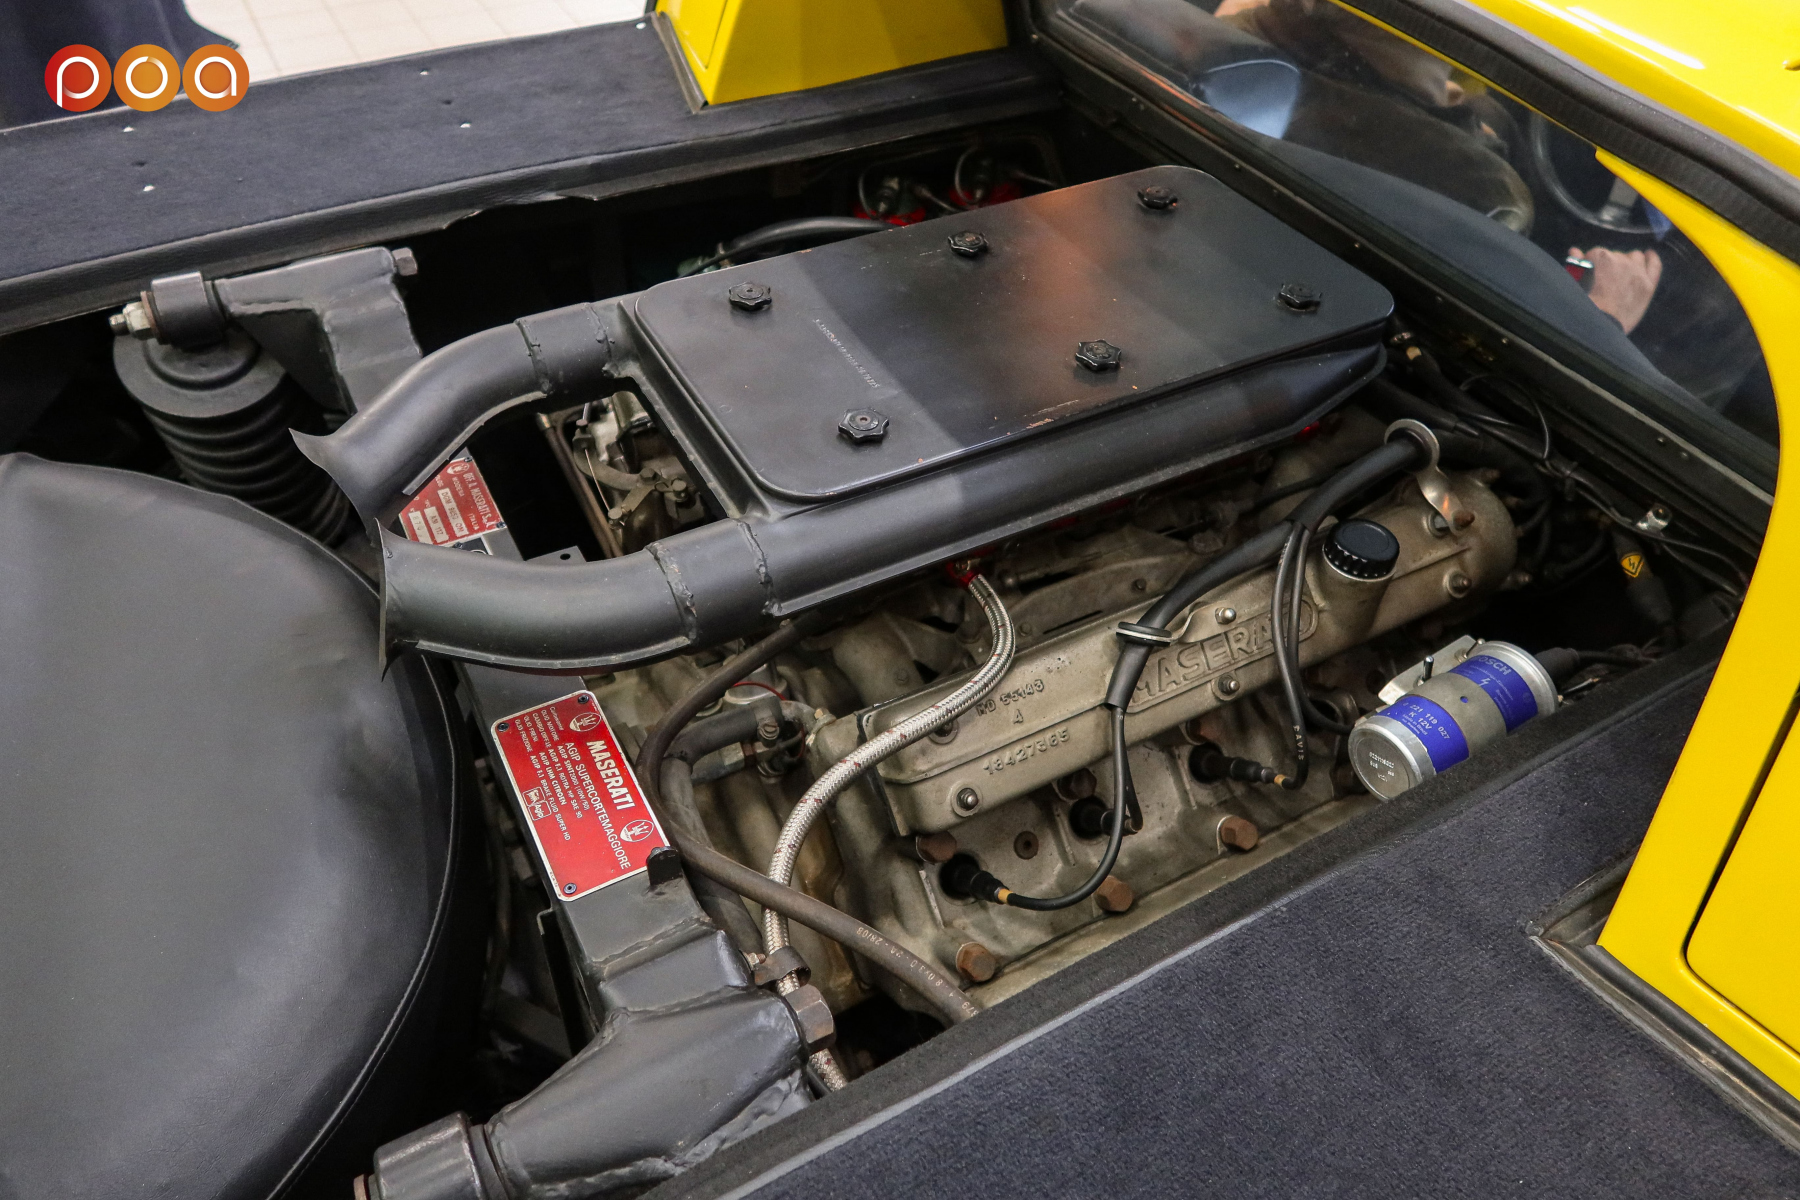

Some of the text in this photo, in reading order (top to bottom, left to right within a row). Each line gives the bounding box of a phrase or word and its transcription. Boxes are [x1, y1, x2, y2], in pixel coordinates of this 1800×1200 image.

[469, 488, 490, 513] MASERATI
[467, 513, 480, 529] ITALIA
[1131, 612, 1274, 704] MASERA
[1418, 718, 1432, 729] 12V
[1438, 726, 1450, 739] 027
[556, 744, 568, 758] AGIP
[538, 751, 549, 766] AGIP
[550, 780, 567, 805] CITROEN
[547, 748, 558, 762] AGIP
[570, 799, 579, 809] SAE
[585, 740, 635, 809] MASERATI
[529, 754, 540, 769] AGIP
[540, 779, 552, 796] BRAKE
[547, 797, 559, 812] FLUID
[554, 813, 567, 830] SUPER
[562, 831, 570, 840] HD
[532, 804, 545, 817] Agip
[564, 741, 581, 761] AGIP
[574, 763, 631, 869] SUPERCORTEMAGGIORE
